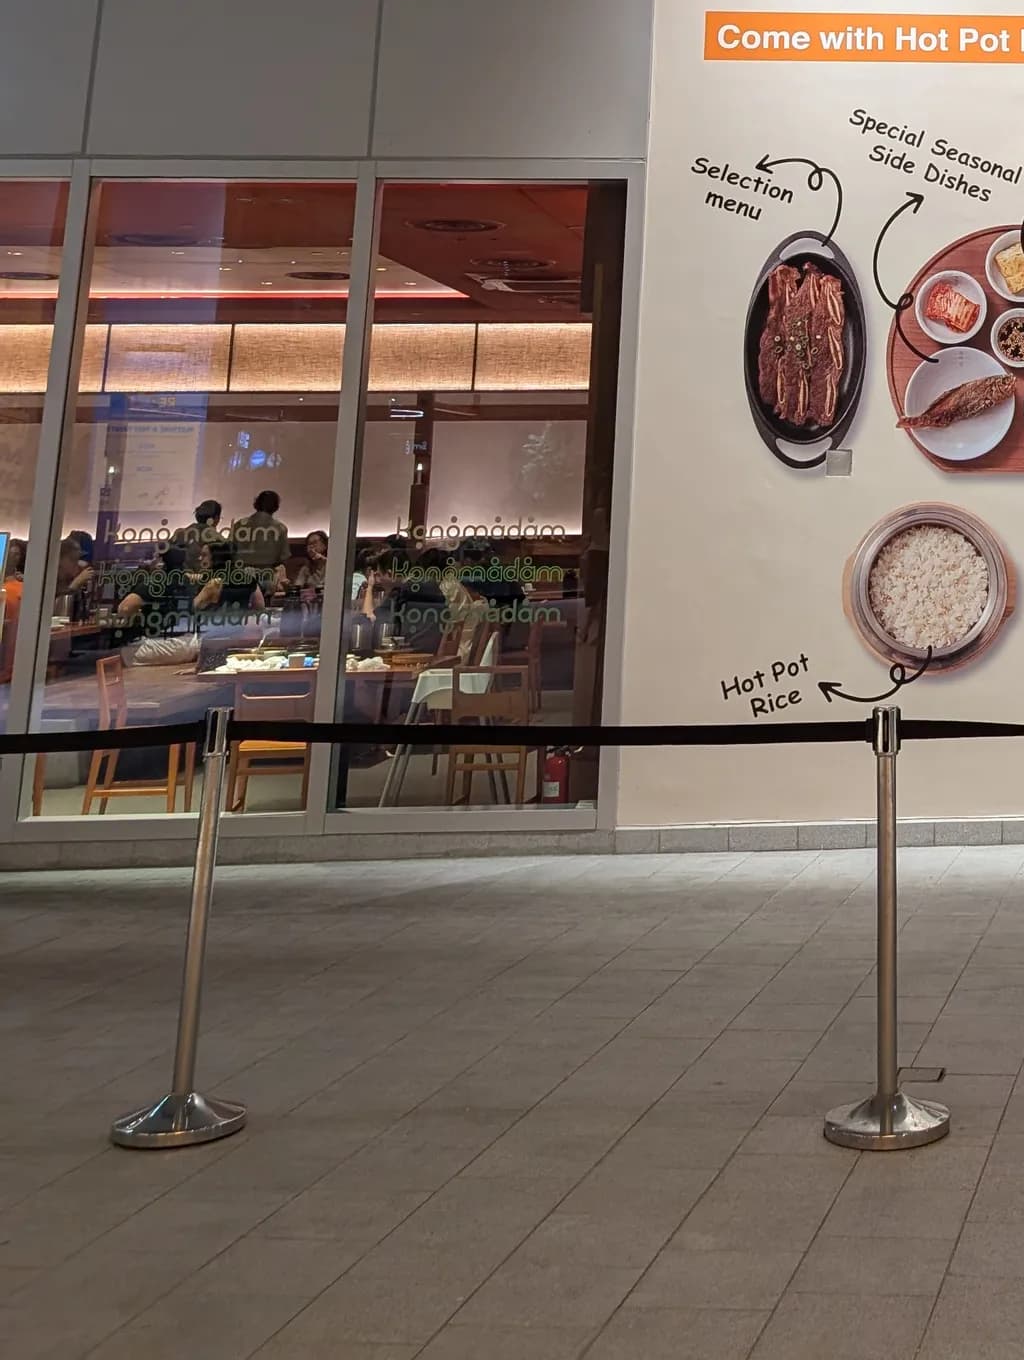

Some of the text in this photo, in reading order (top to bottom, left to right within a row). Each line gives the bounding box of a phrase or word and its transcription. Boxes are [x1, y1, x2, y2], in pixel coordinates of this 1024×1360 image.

[717, 24, 812, 50] Come
[819, 26, 884, 51] with
[895, 27, 949, 52] Hot
[959, 28, 1010, 53] Pot
[848, 108, 1024, 185] Special Seasonal
[690, 156, 795, 204] Selection
[868, 144, 993, 203] Side Dishes
[704, 190, 763, 221] menu
[720, 653, 810, 701] Hot Pot
[750, 689, 803, 718] Rice
